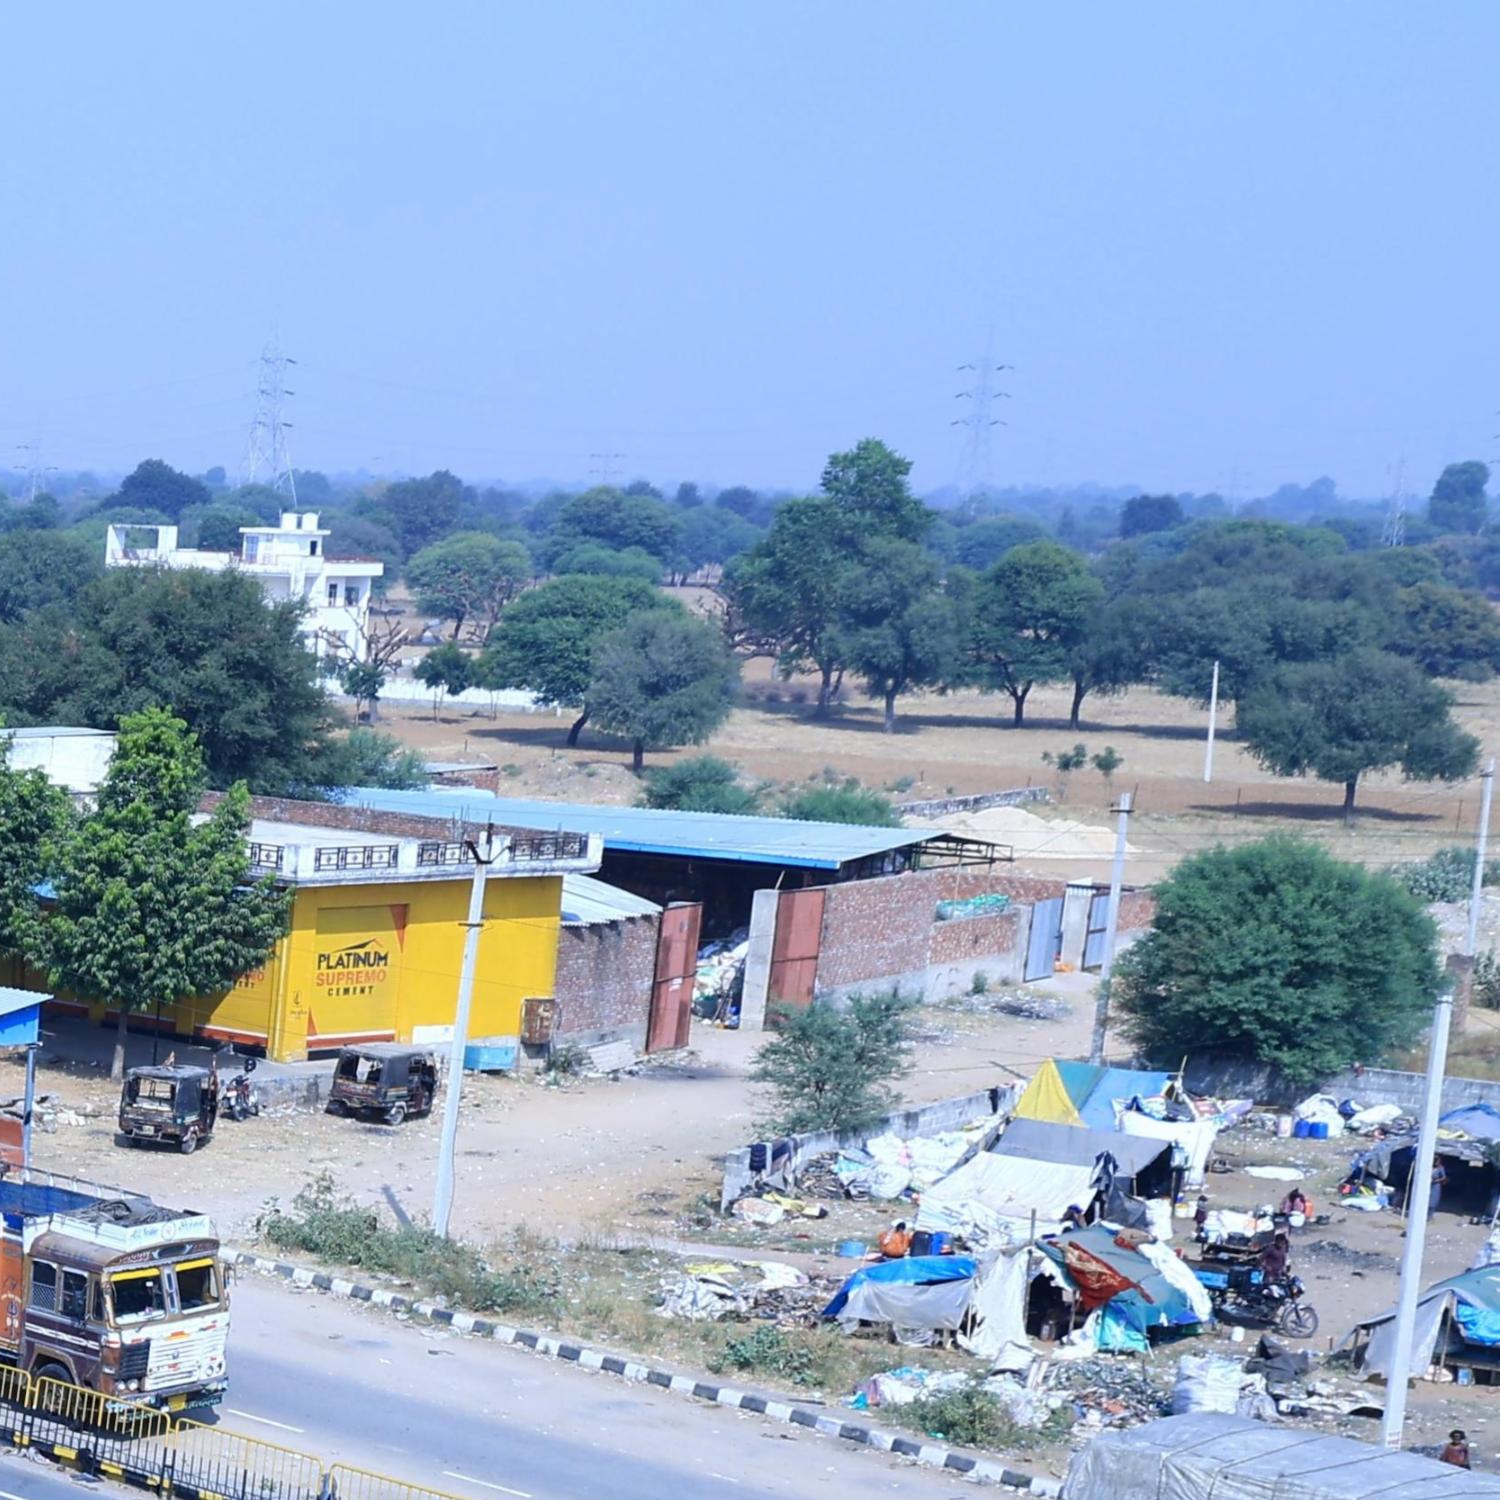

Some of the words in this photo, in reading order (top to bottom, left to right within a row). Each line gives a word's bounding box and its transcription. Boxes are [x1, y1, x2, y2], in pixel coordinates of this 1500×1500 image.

[316, 951, 389, 970] PLATINUM
[315, 969, 387, 987] SUPREMO
[327, 985, 374, 996] CEMENT
